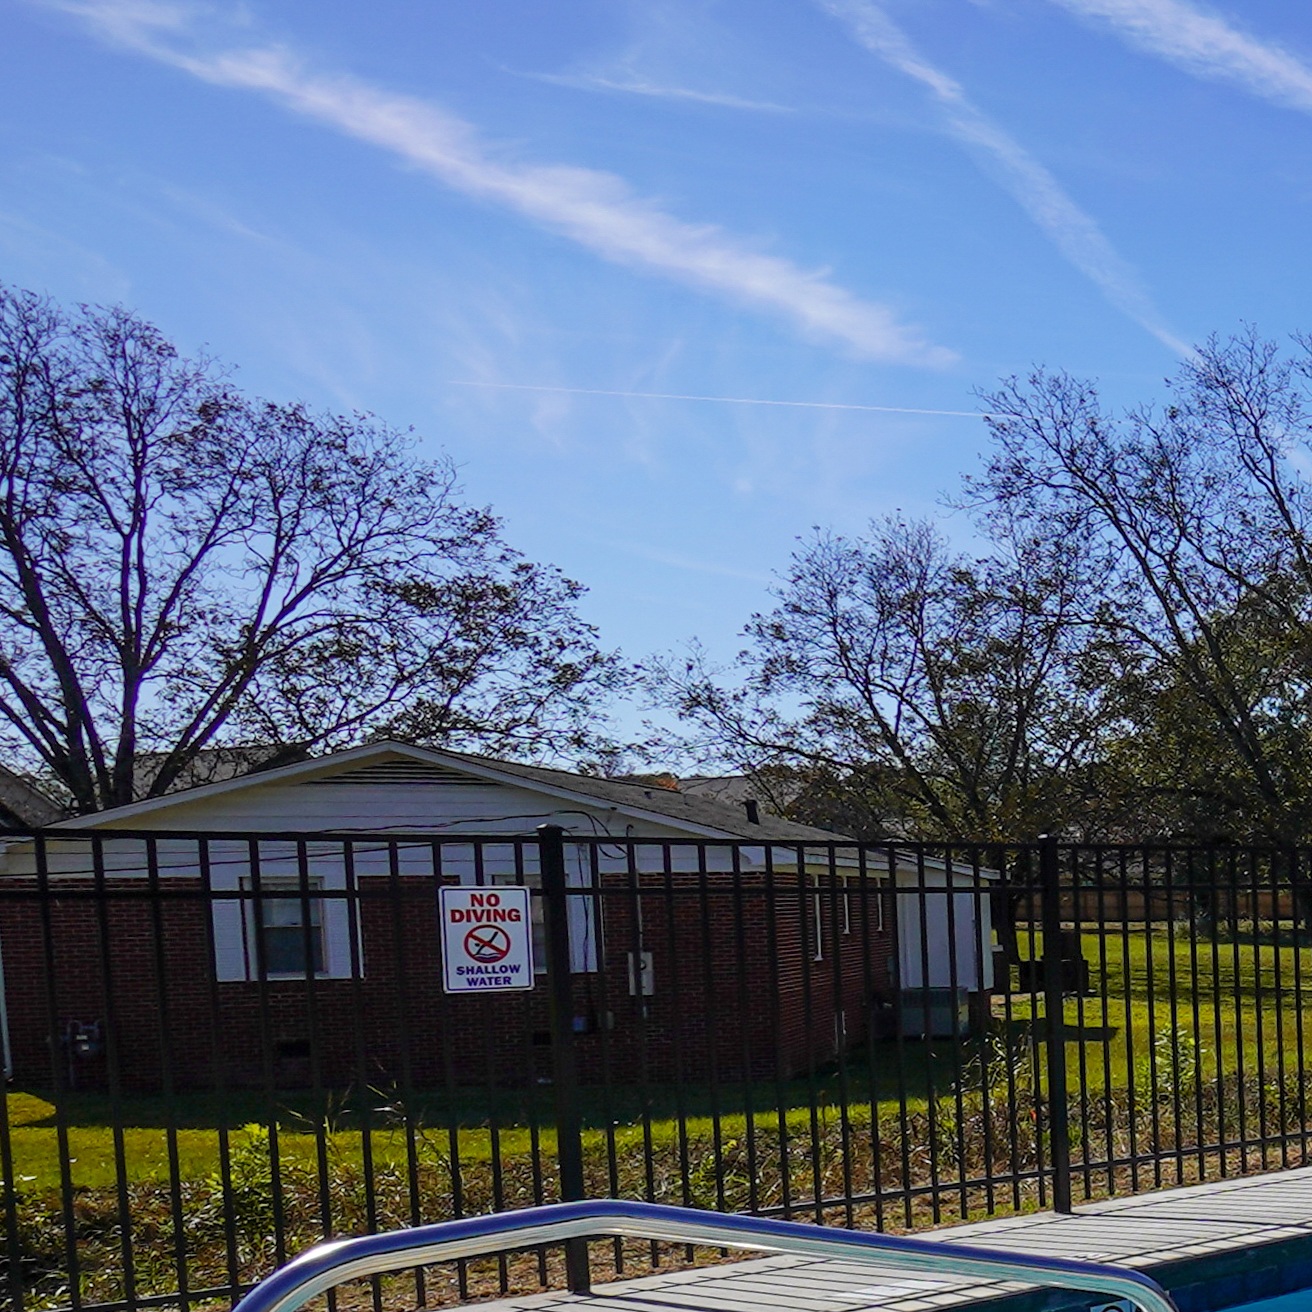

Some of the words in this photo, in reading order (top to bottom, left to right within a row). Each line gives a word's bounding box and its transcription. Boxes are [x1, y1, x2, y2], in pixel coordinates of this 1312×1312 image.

[470, 893, 501, 907] NO
[450, 908, 521, 923] DIVING
[456, 964, 521, 976] SHALLOW
[466, 976, 512, 987] WATER
